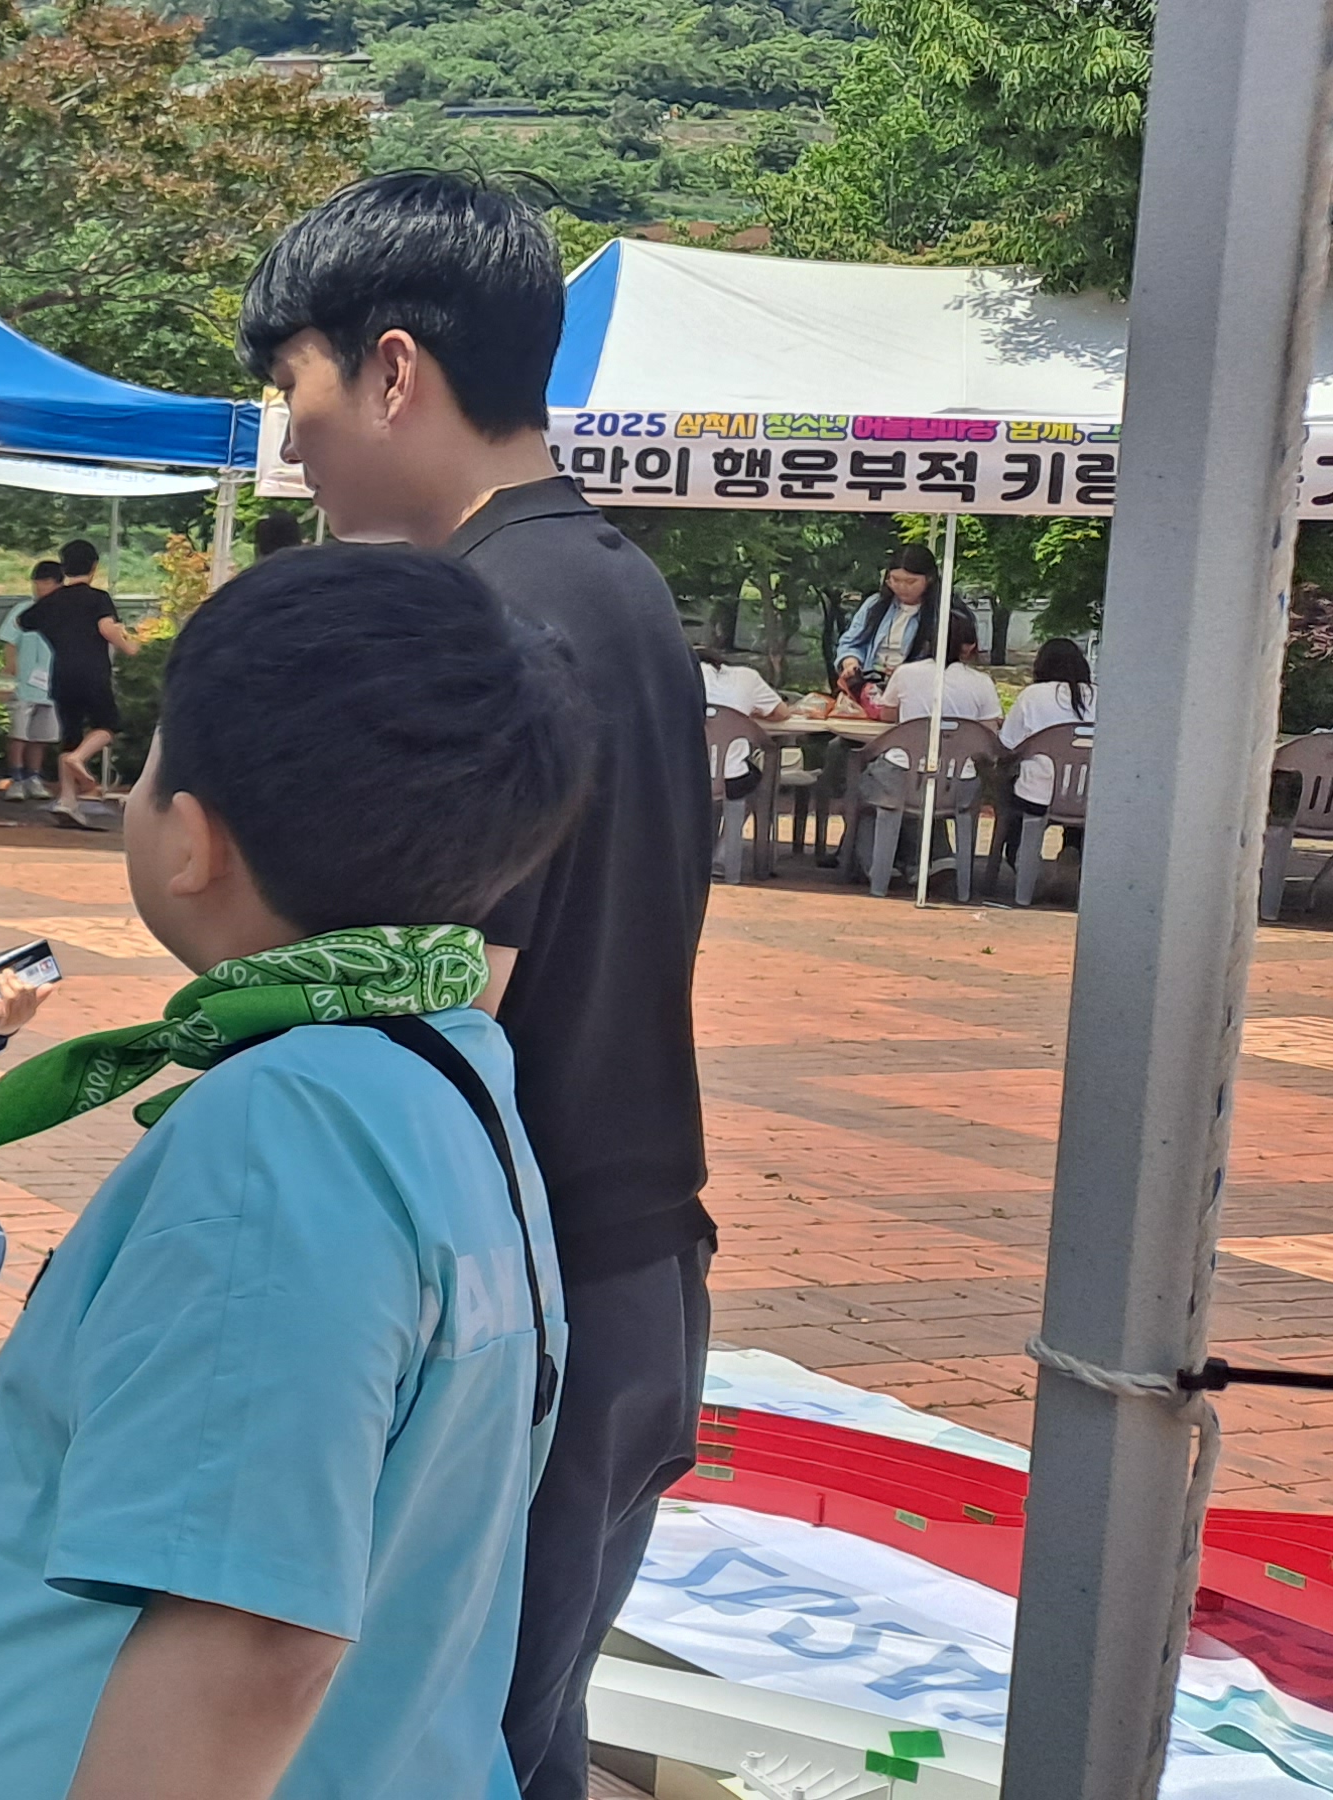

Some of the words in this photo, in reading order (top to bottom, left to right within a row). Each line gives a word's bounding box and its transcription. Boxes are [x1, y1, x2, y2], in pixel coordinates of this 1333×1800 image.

[574, 413, 667, 437] 2025
[675, 413, 759, 439] 삼척시
[763, 413, 847, 440] 청소년
[712, 448, 978, 502] 행운부적
